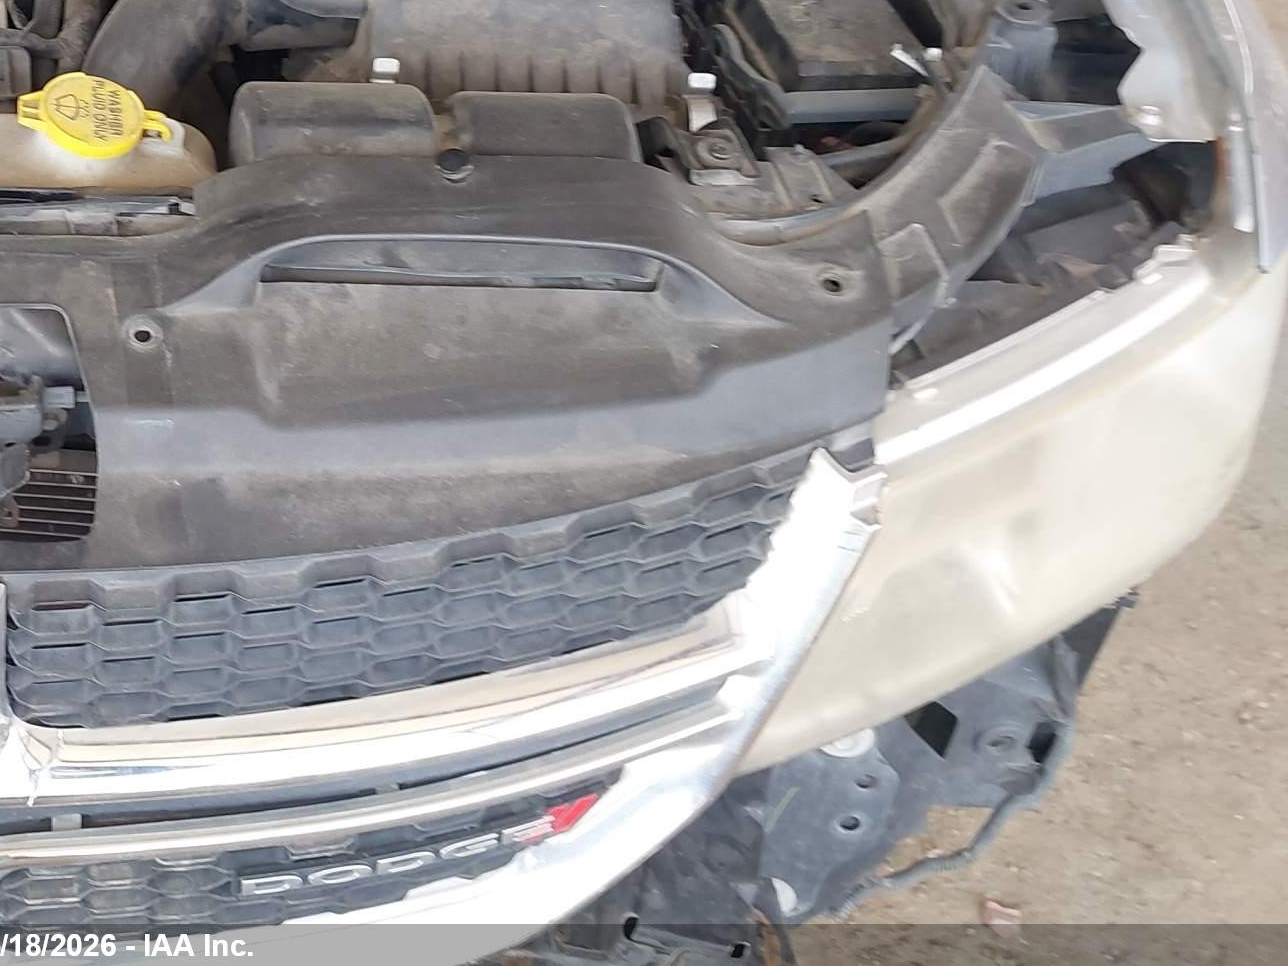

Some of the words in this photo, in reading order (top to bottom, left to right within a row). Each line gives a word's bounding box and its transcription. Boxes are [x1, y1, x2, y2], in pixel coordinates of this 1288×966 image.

[91, 79, 107, 110] FLUID
[107, 90, 124, 136] WASHER
[93, 113, 108, 142] ONLY
[240, 814, 557, 896] DODGE
